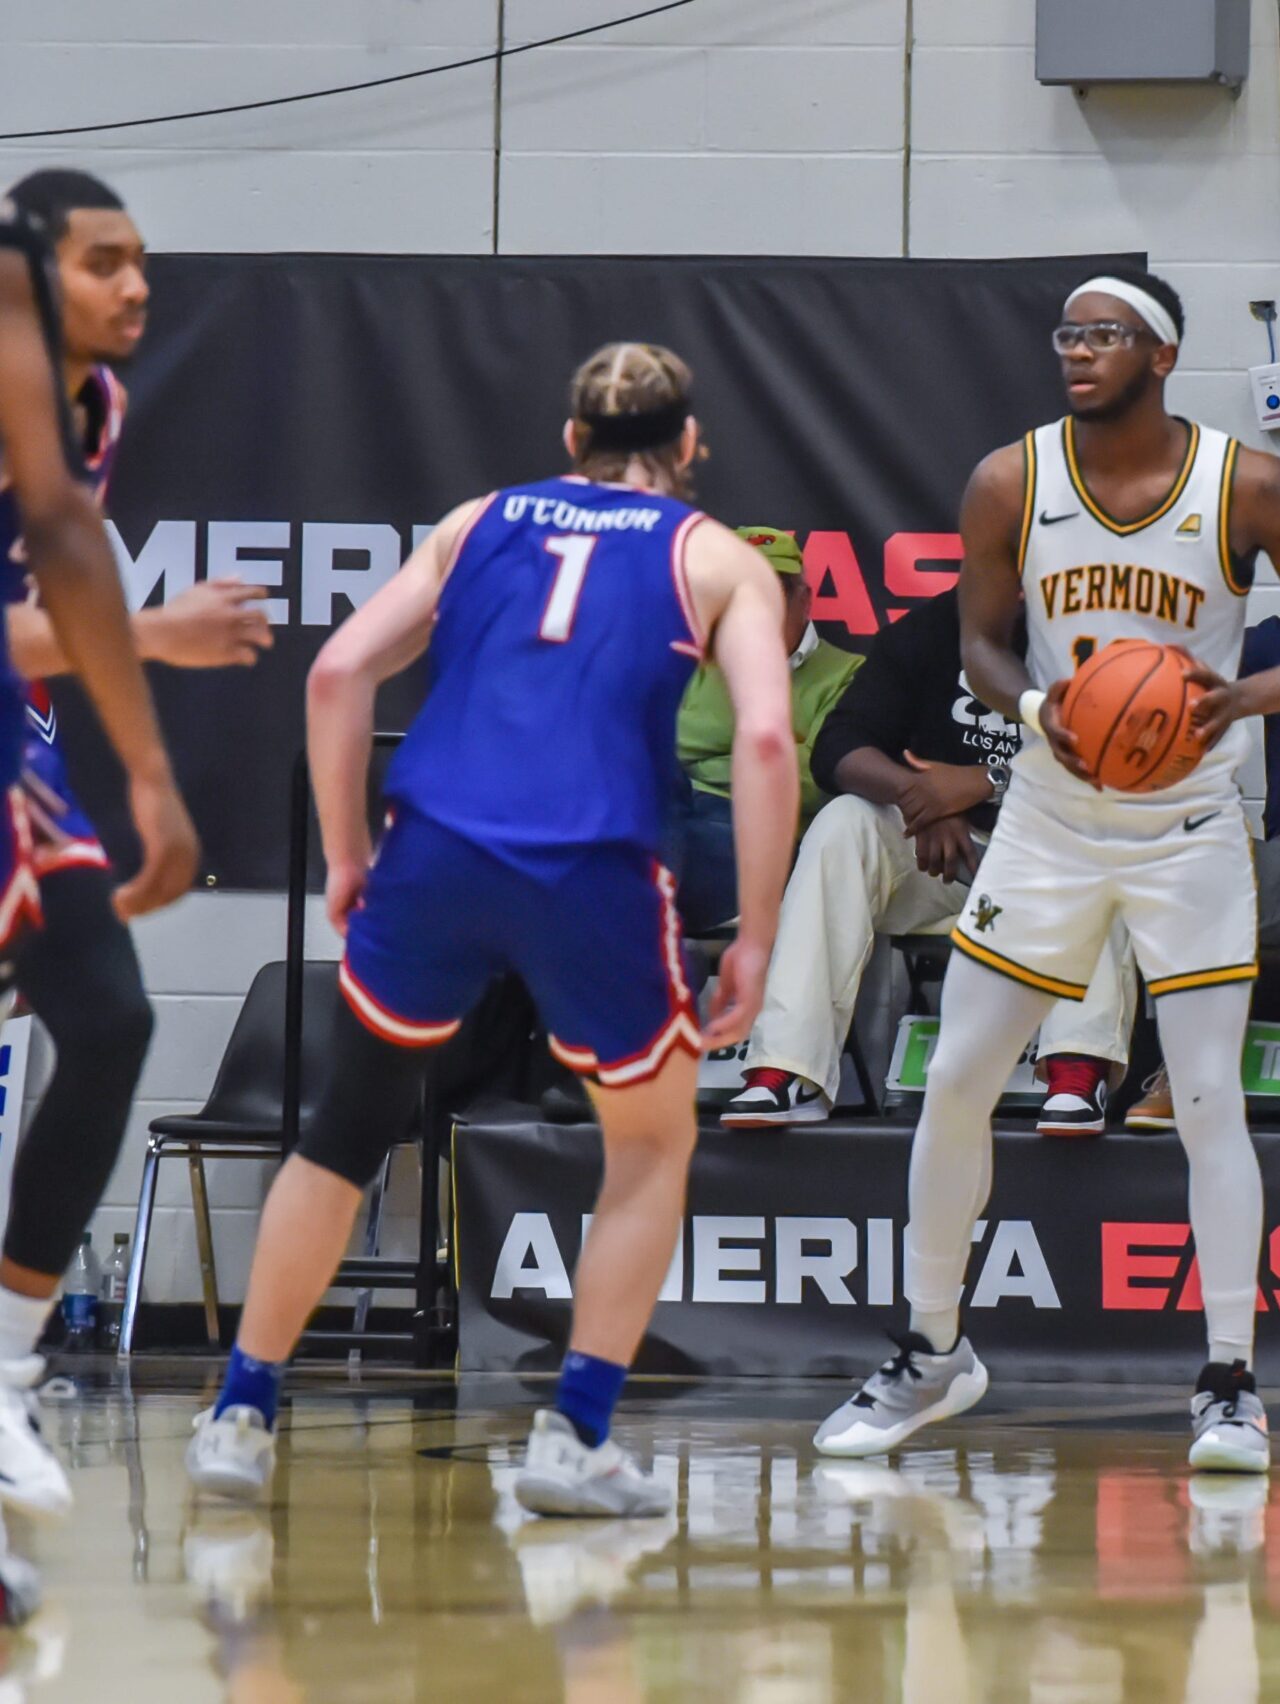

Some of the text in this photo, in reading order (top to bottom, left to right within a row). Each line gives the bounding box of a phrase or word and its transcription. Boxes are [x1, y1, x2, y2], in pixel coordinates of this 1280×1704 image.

[503, 494, 662, 532] O'CONNOR
[537, 534, 599, 643] 1
[1039, 563, 1206, 630] VERMONT
[994, 740, 1017, 755] AN
[490, 1211, 1062, 1309] AERIA
